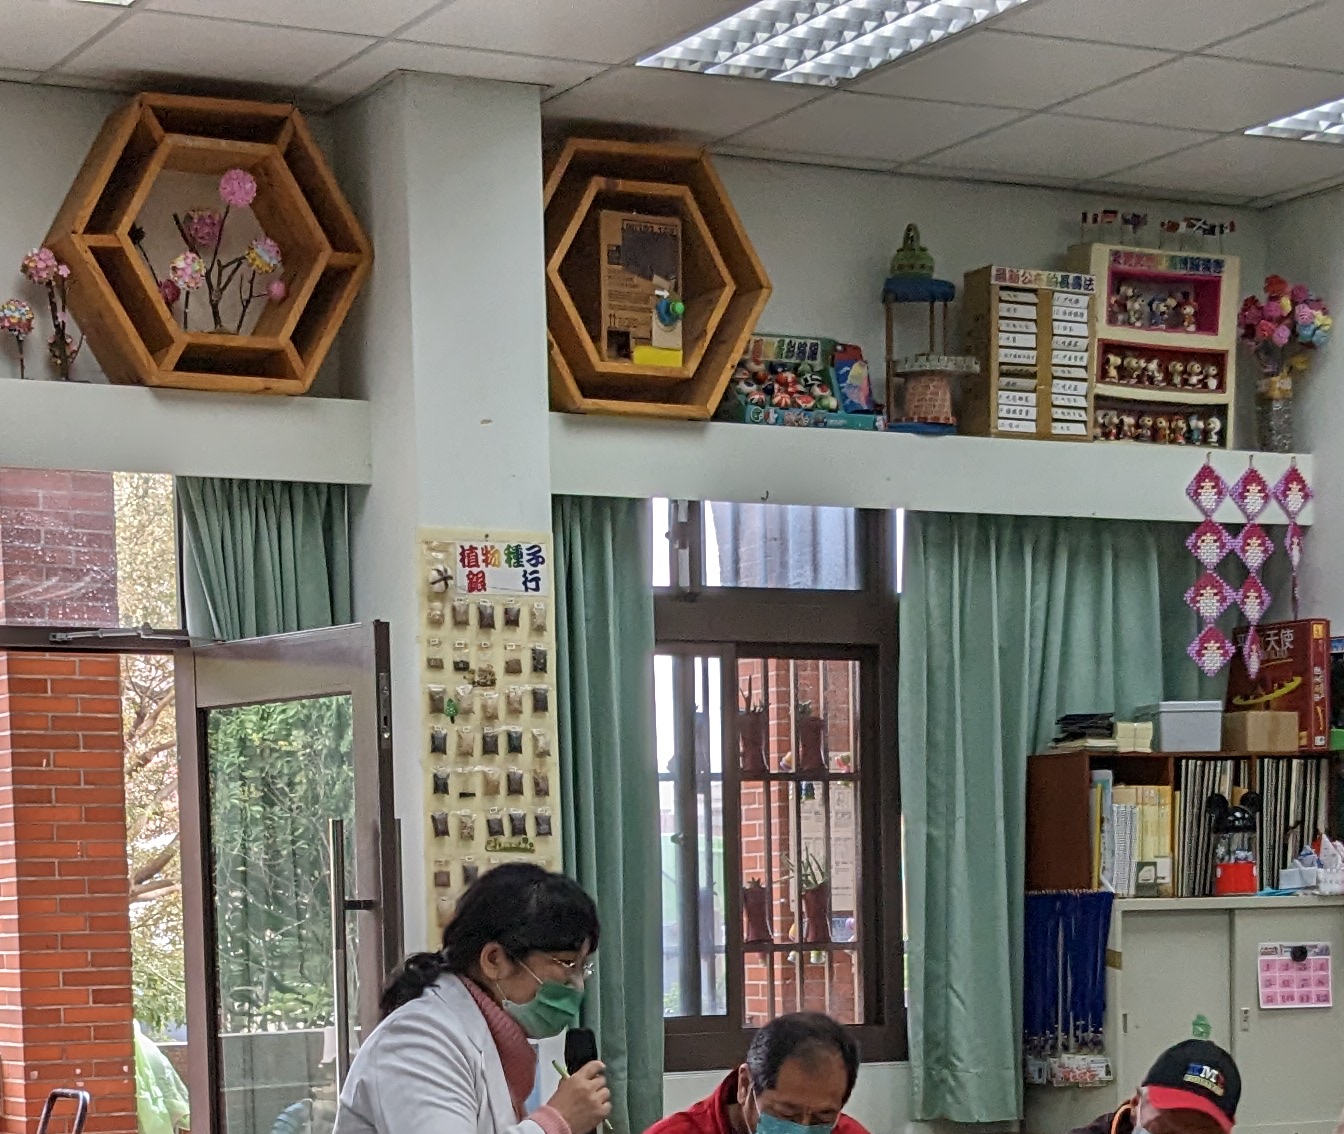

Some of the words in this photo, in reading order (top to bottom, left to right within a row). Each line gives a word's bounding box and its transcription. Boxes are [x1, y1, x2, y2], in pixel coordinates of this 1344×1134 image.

[459, 544, 545, 569] 植物種子
[466, 570, 541, 593] 銀行
